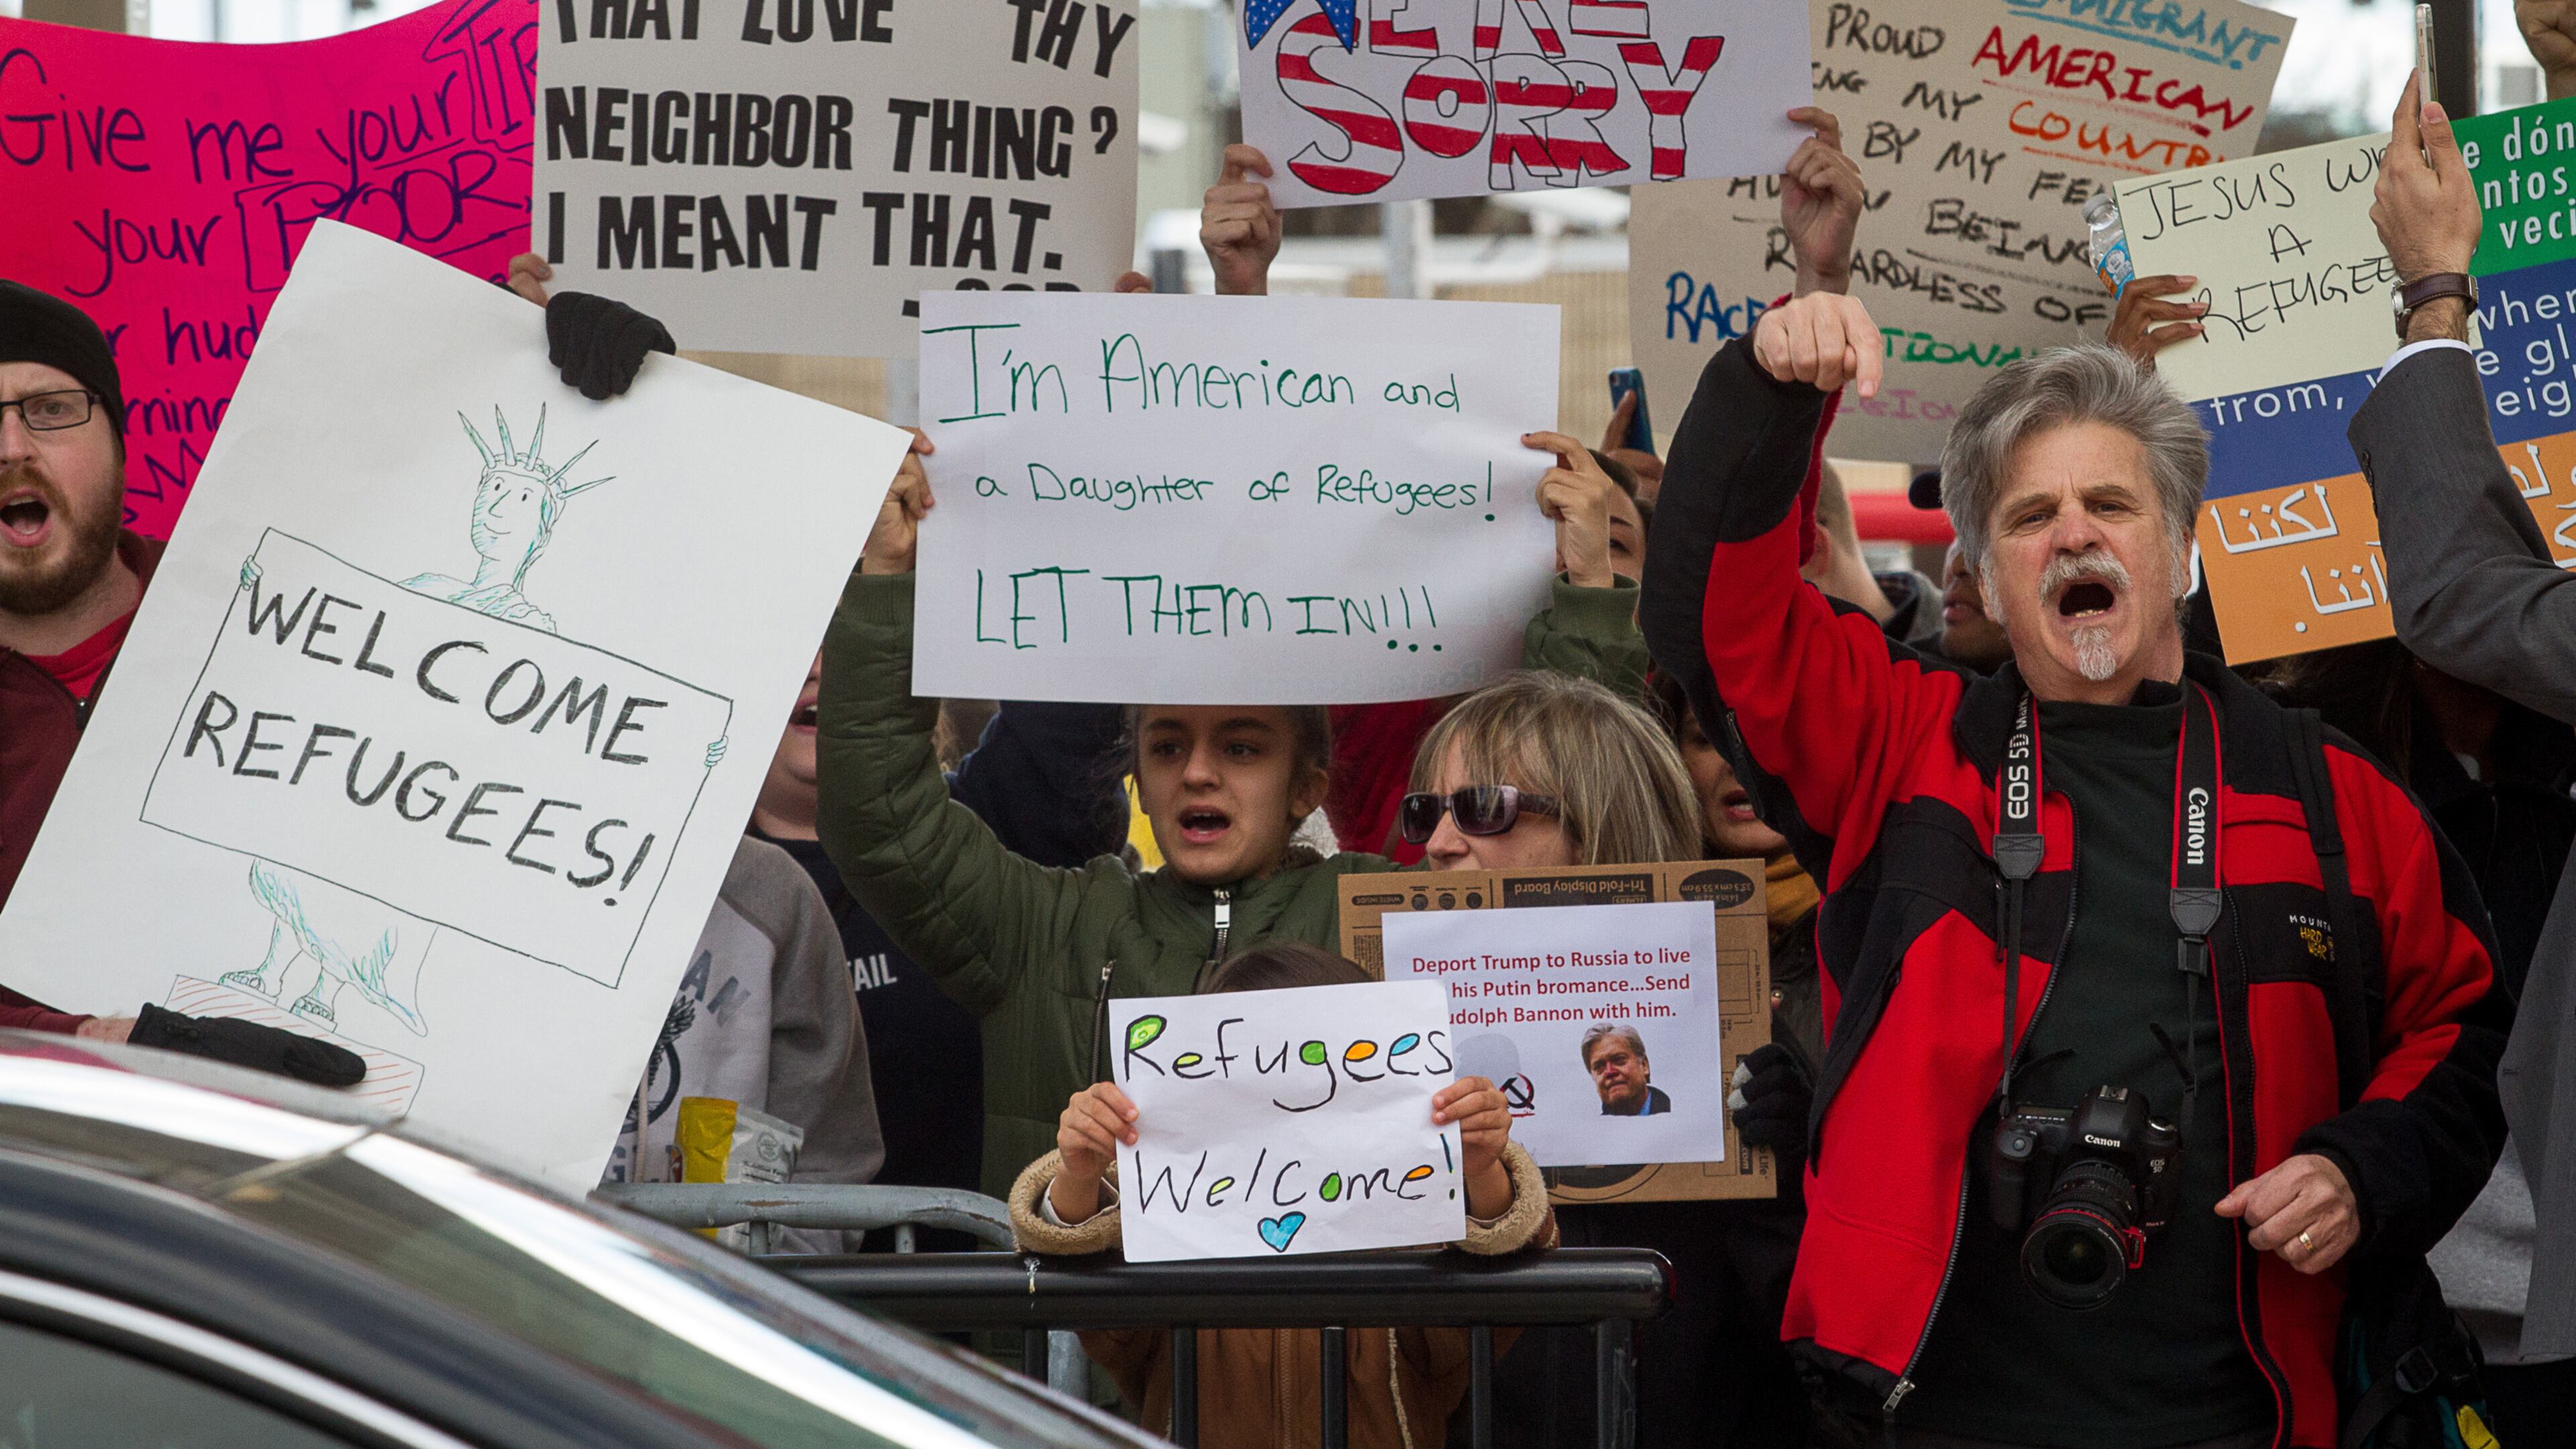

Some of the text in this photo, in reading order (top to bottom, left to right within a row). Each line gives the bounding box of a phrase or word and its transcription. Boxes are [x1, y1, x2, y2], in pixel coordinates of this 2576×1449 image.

[553, 0, 1136, 79] THAT LOVE THY
[1825, 3, 2254, 130] PROUD AMERICAN
[0, 48, 150, 172] Give
[184, 118, 294, 184] me
[316, 70, 459, 205] your
[545, 85, 853, 170] NEIGHBOR
[1276, 13, 1725, 195] SORRY
[1901, 82, 1984, 122] MY
[2009, 100, 2225, 168] COUNTR
[1863, 121, 1921, 164] BY
[1935, 140, 2006, 184] MY
[547, 192, 1063, 274] I MEANT THAT.
[2123, 163, 2295, 240] JESUS
[65, 209, 223, 297] your
[2269, 224, 2312, 262] A
[2034, 297, 2107, 325] OF
[922, 323, 1460, 423] I'm American and
[2496, 364, 2576, 418] eig
[975, 460, 1497, 523] a Daughter of Refugees!
[976, 566, 1091, 649] LET
[1101, 575, 1272, 637] THEM
[248, 580, 668, 765] WELCOME
[2008, 733, 2030, 759] 5D
[2016, 699, 2029, 731] Mark
[183, 690, 655, 907] REFUGEES!
[2008, 765, 2029, 819] EOS
[2187, 787, 2209, 865] Canon
[1514, 878, 1646, 896] Tri-Fold Display Board
[2289, 914, 2331, 932] MOUNTA
[847, 953, 898, 991] AIL
[1412, 948, 1690, 975] Deport Trump to Russia to live
[1484, 979, 1531, 997] Putin
[1513, 1006, 1583, 1023] Bannon
[1589, 1002, 1630, 1020] with
[1635, 1001, 1676, 1018] him.
[1124, 1014, 1453, 1112] Refugees
[2084, 1134, 2121, 1148] Canon
[2150, 1159, 2165, 1167] EOS
